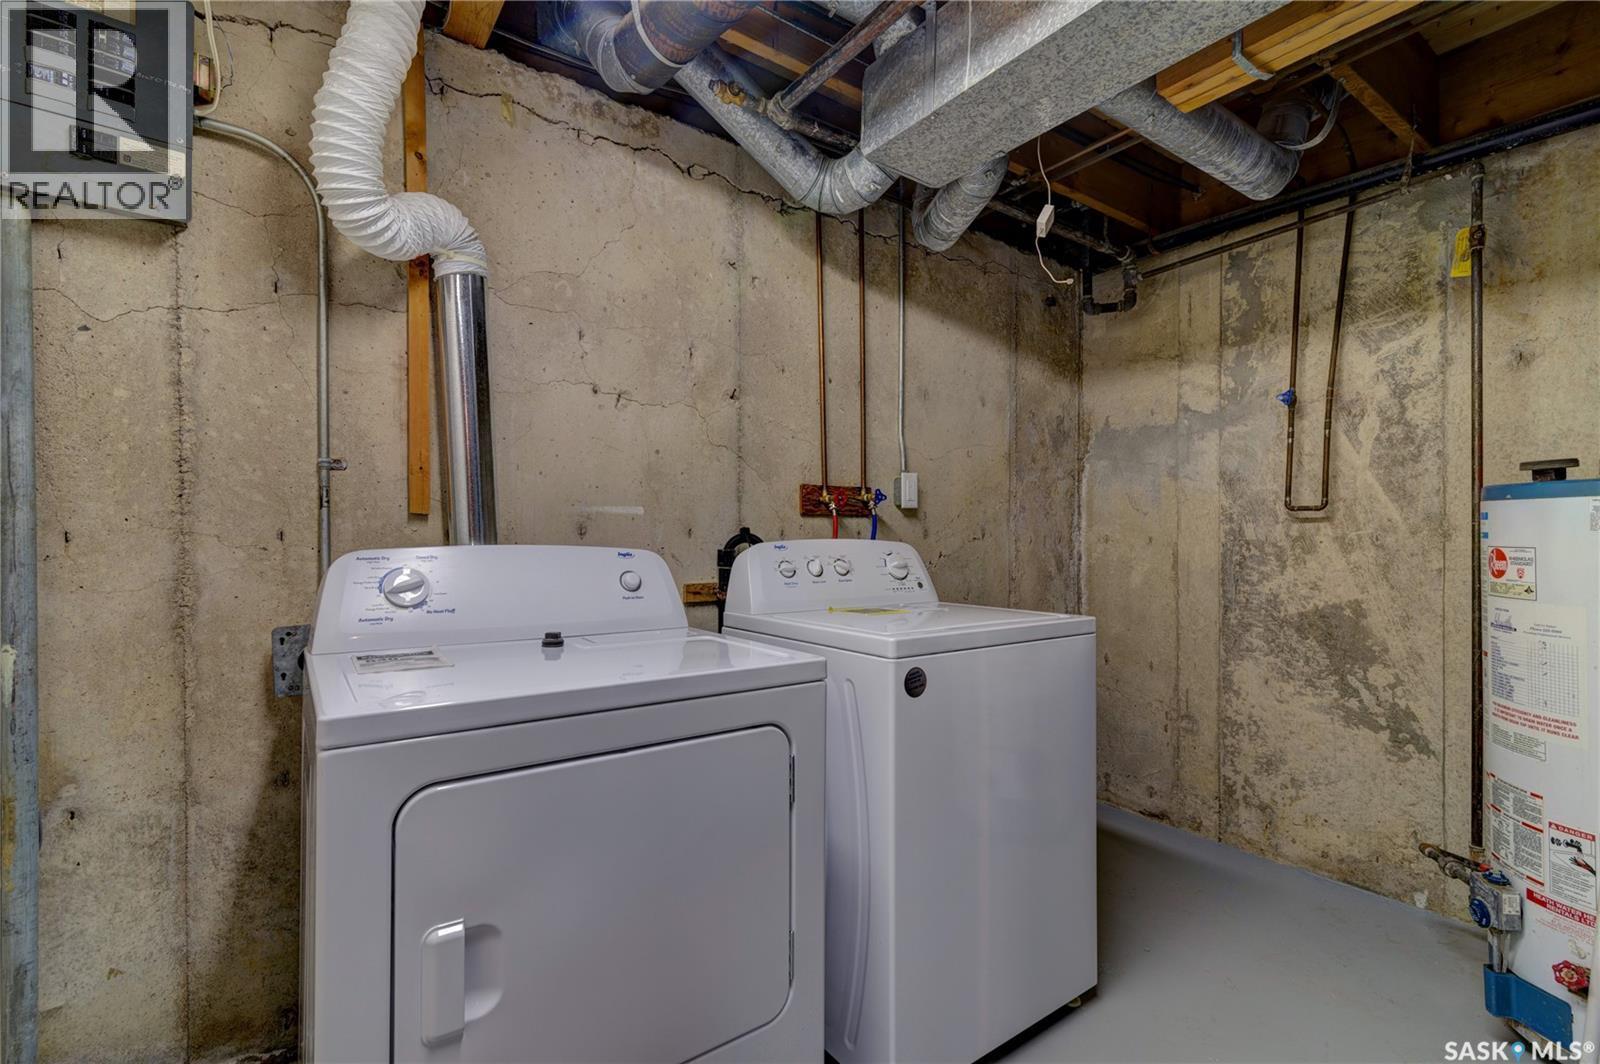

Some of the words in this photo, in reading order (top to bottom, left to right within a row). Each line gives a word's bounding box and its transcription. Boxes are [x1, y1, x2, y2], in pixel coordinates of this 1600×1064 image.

[1559, 826, 1593, 840] DANGER
[1533, 892, 1553, 906] HEATH
[1555, 901, 1581, 917] WATER
[1547, 903, 1579, 921] RENTALS
